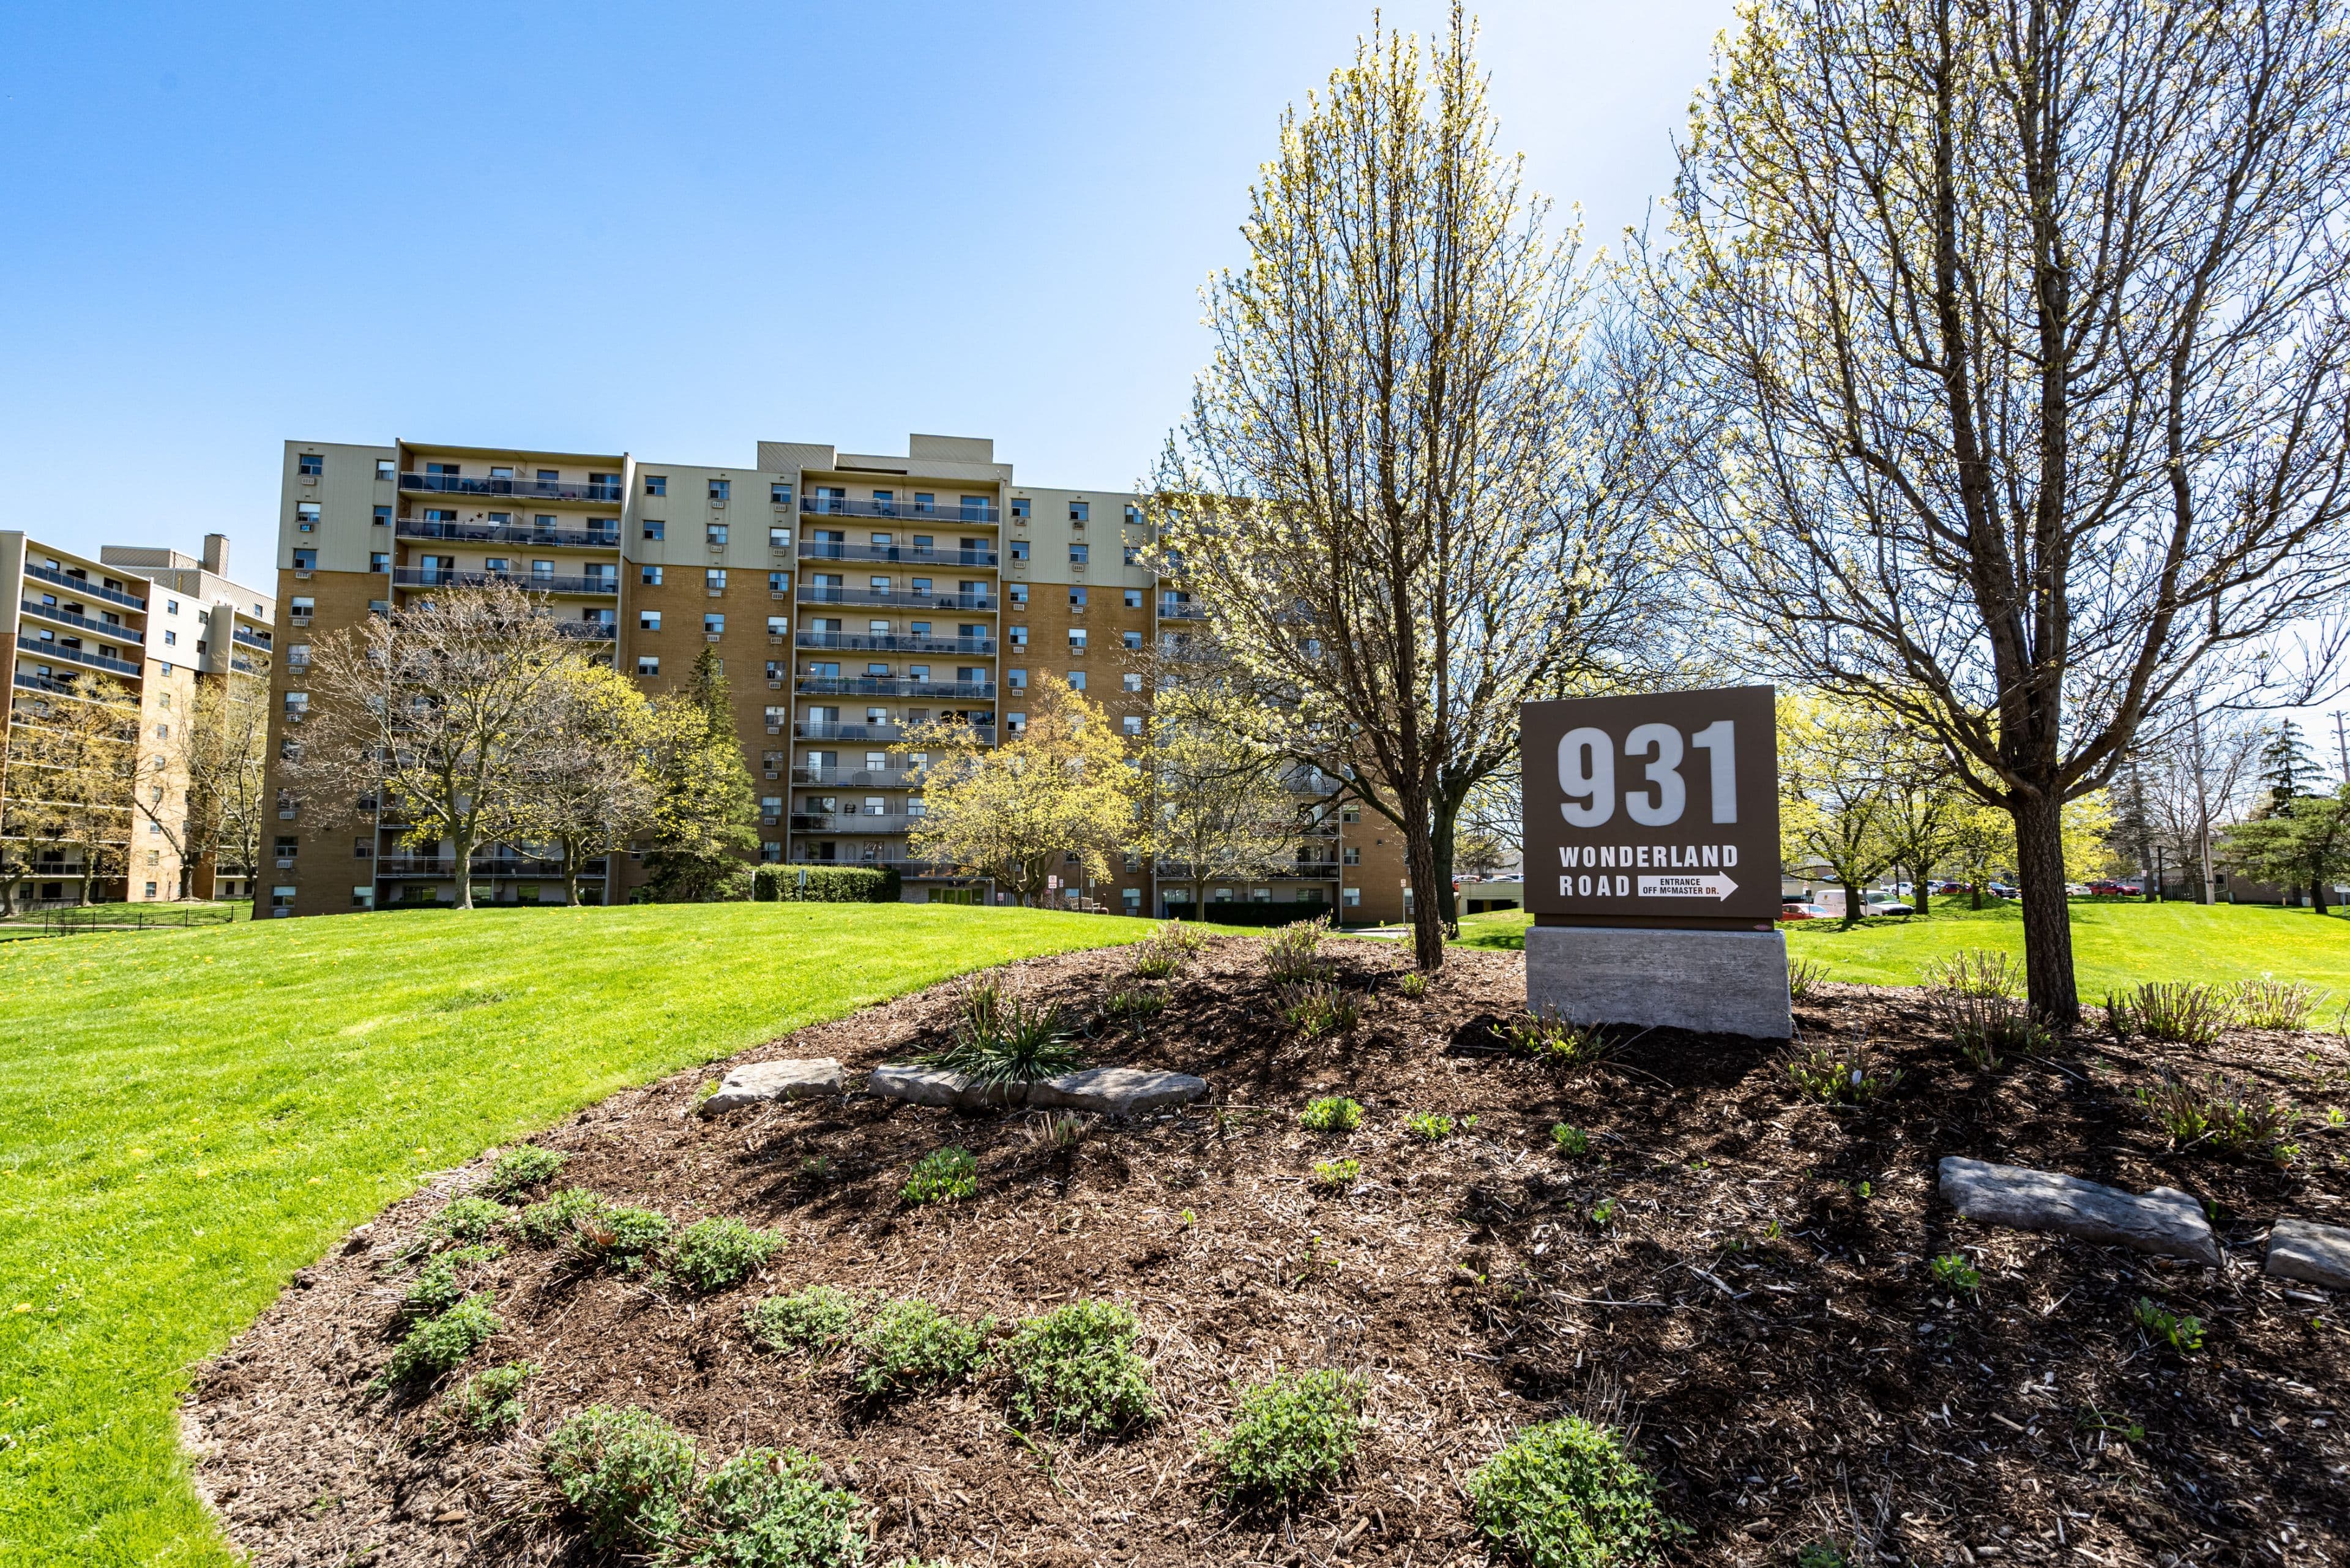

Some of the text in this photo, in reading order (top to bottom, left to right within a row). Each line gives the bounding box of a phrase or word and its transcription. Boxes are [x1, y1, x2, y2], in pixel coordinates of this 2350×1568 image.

[1558, 720, 1737, 827] 931
[1559, 845, 1737, 868] WONDERLAND
[1559, 875, 1630, 897] ROAD
